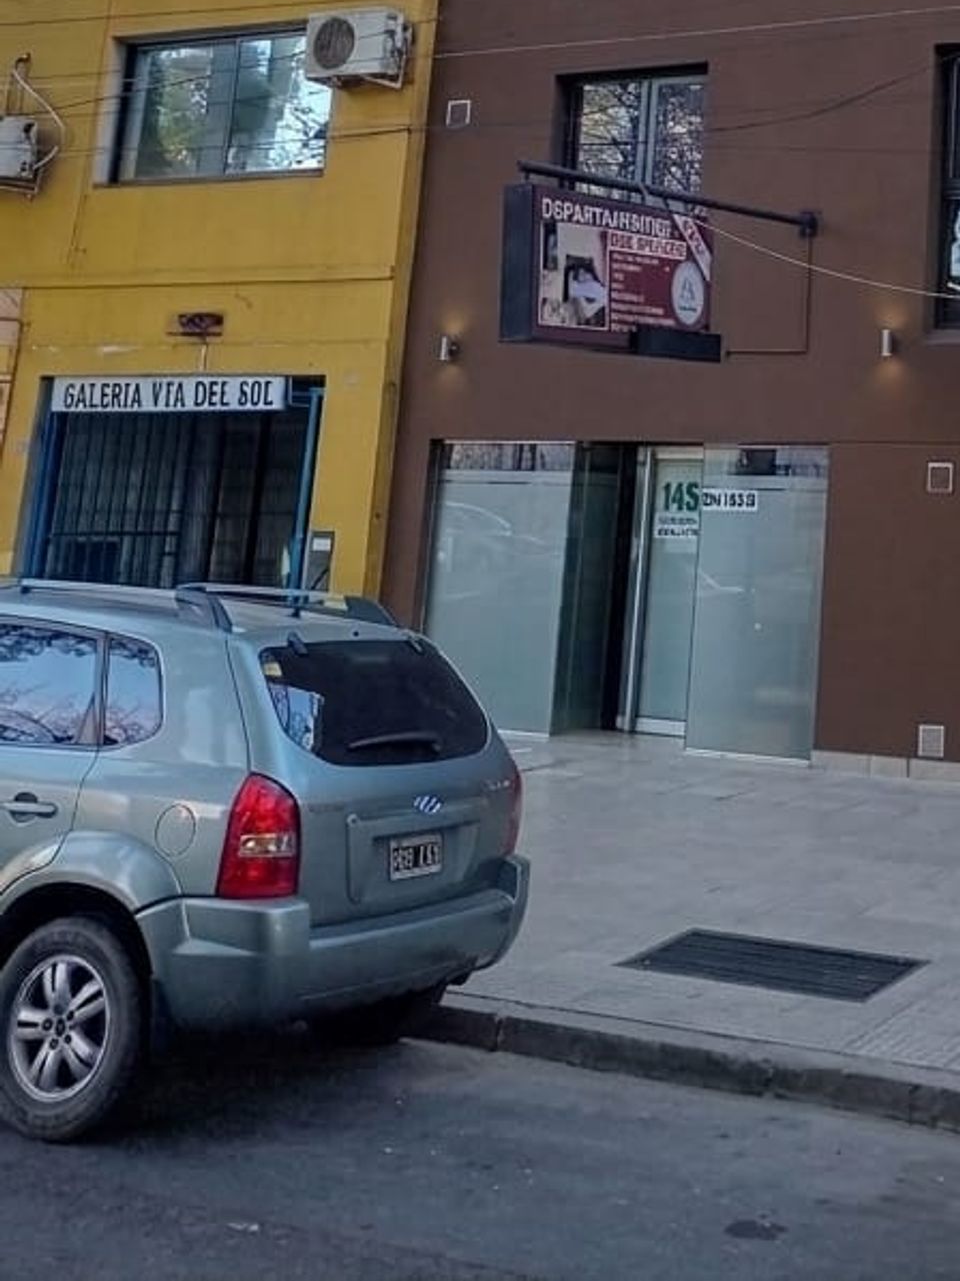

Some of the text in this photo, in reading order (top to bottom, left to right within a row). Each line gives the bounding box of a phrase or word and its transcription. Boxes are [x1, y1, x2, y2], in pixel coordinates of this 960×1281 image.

[63, 382, 142, 409] GALERIA
[193, 380, 230, 407] DEL
[238, 379, 274, 406] SOL
